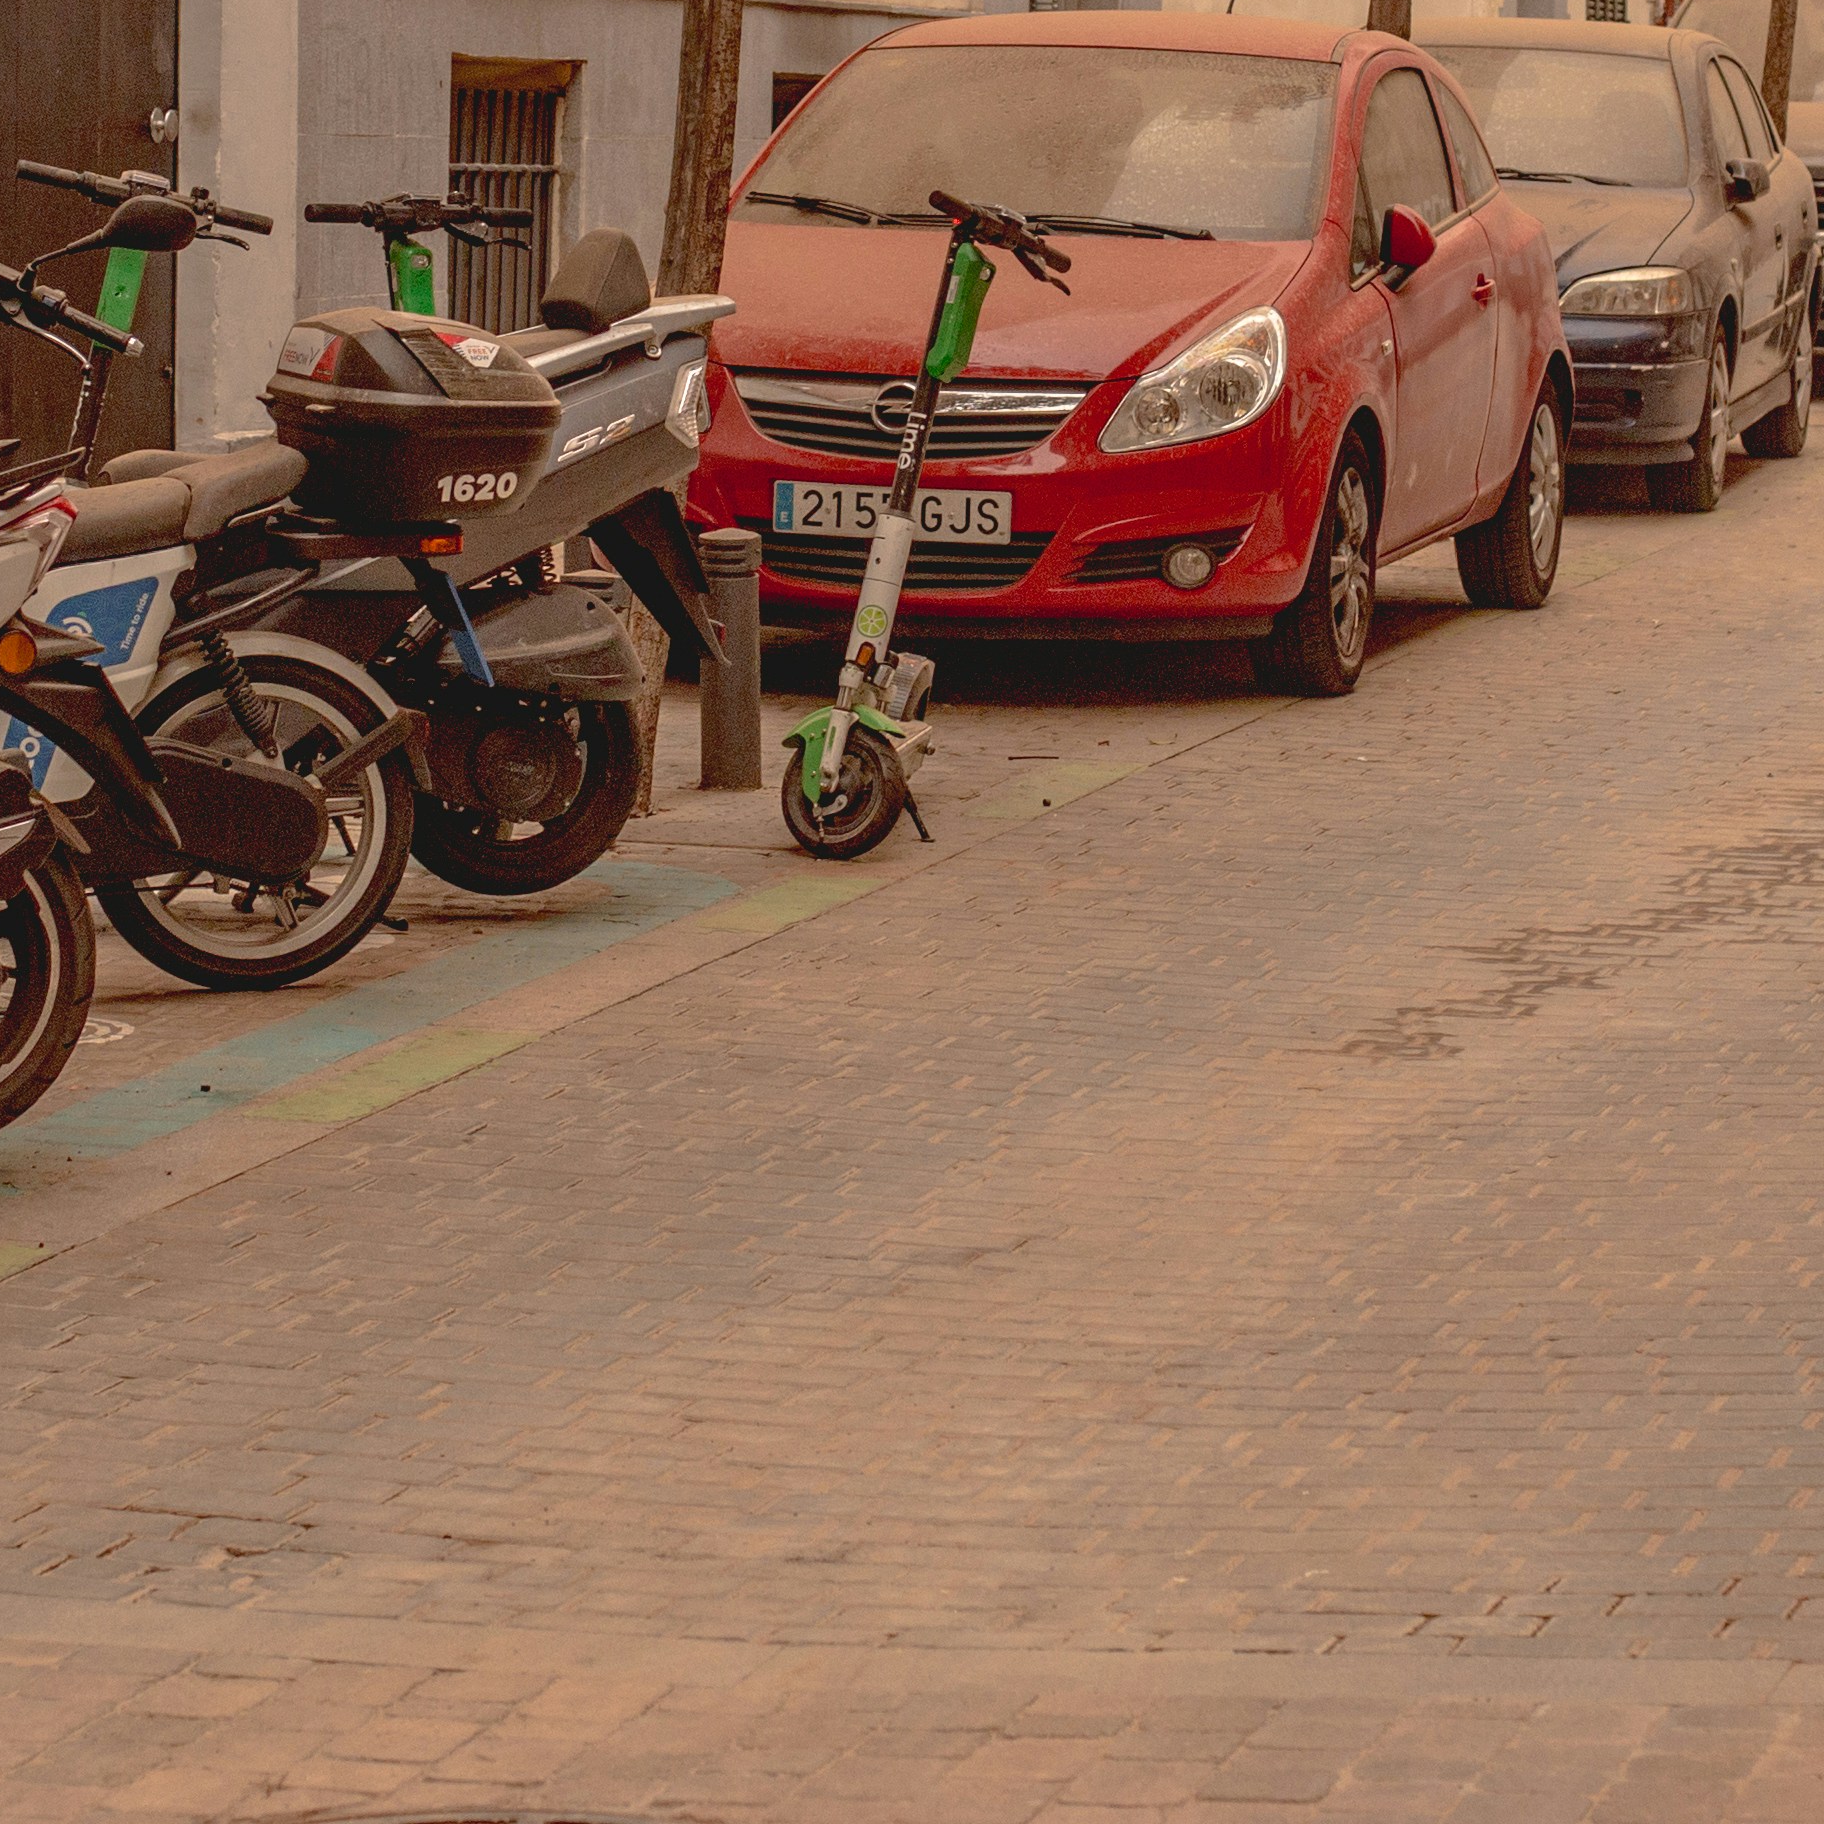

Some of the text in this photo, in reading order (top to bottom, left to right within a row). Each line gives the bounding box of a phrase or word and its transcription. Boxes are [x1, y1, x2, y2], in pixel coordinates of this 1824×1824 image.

[898, 412, 927, 469] Lime
[438, 472, 518, 503] 1620
[780, 512, 789, 523] E
[921, 496, 1000, 535] GJS
[120, 592, 149, 650] Time to ride
